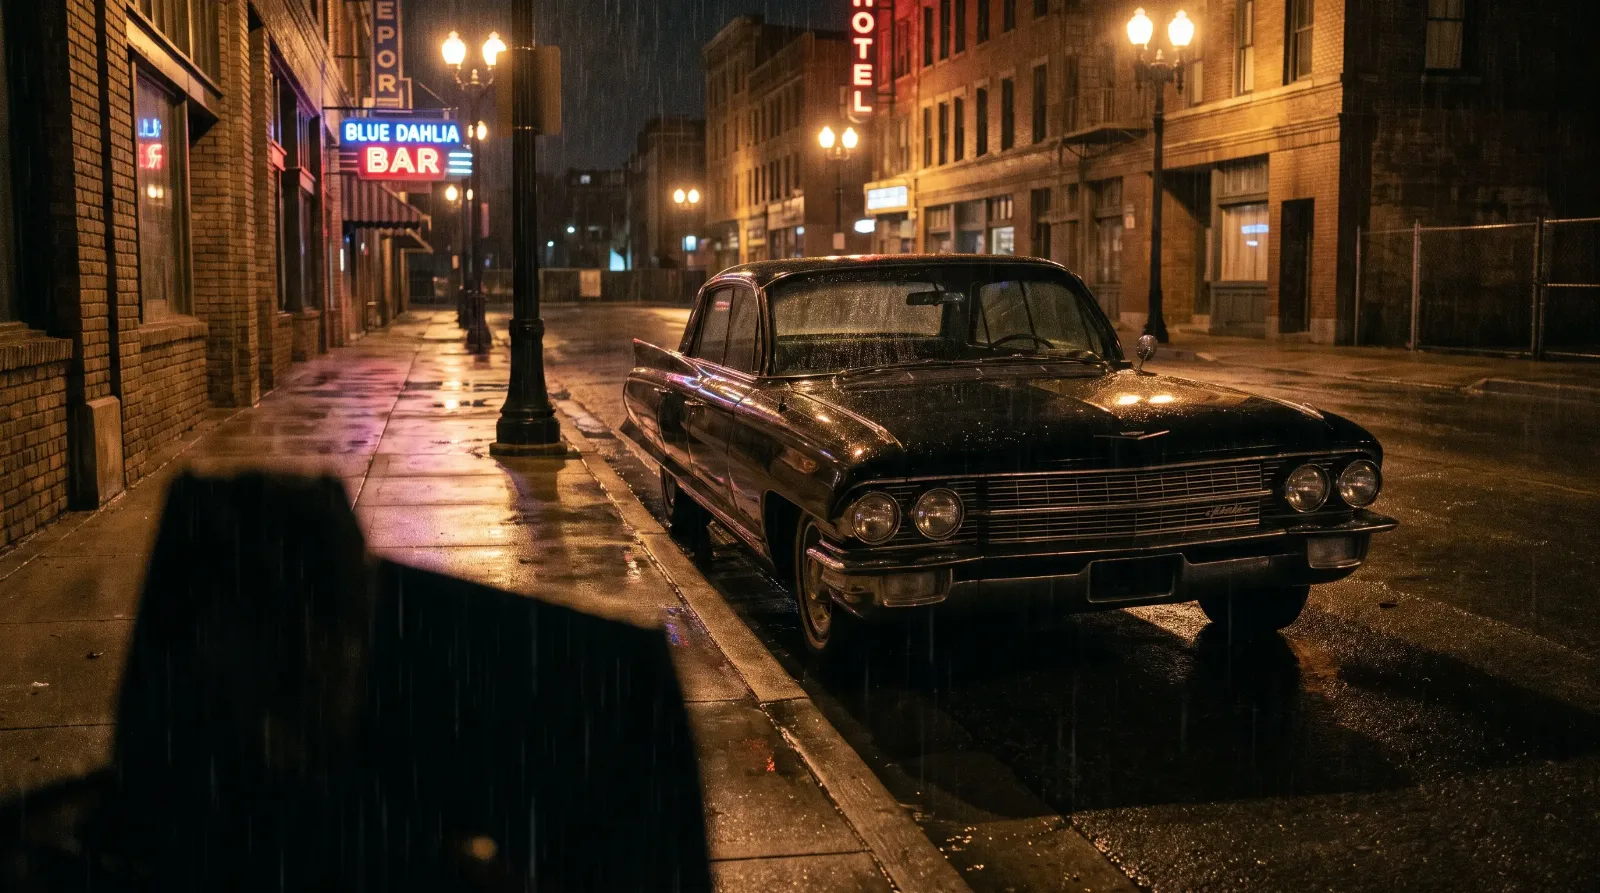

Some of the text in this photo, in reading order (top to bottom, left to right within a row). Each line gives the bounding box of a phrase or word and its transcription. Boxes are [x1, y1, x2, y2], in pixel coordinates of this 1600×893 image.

[345, 123, 460, 143] BLUE DAHLIA
[367, 147, 440, 174] BAR
